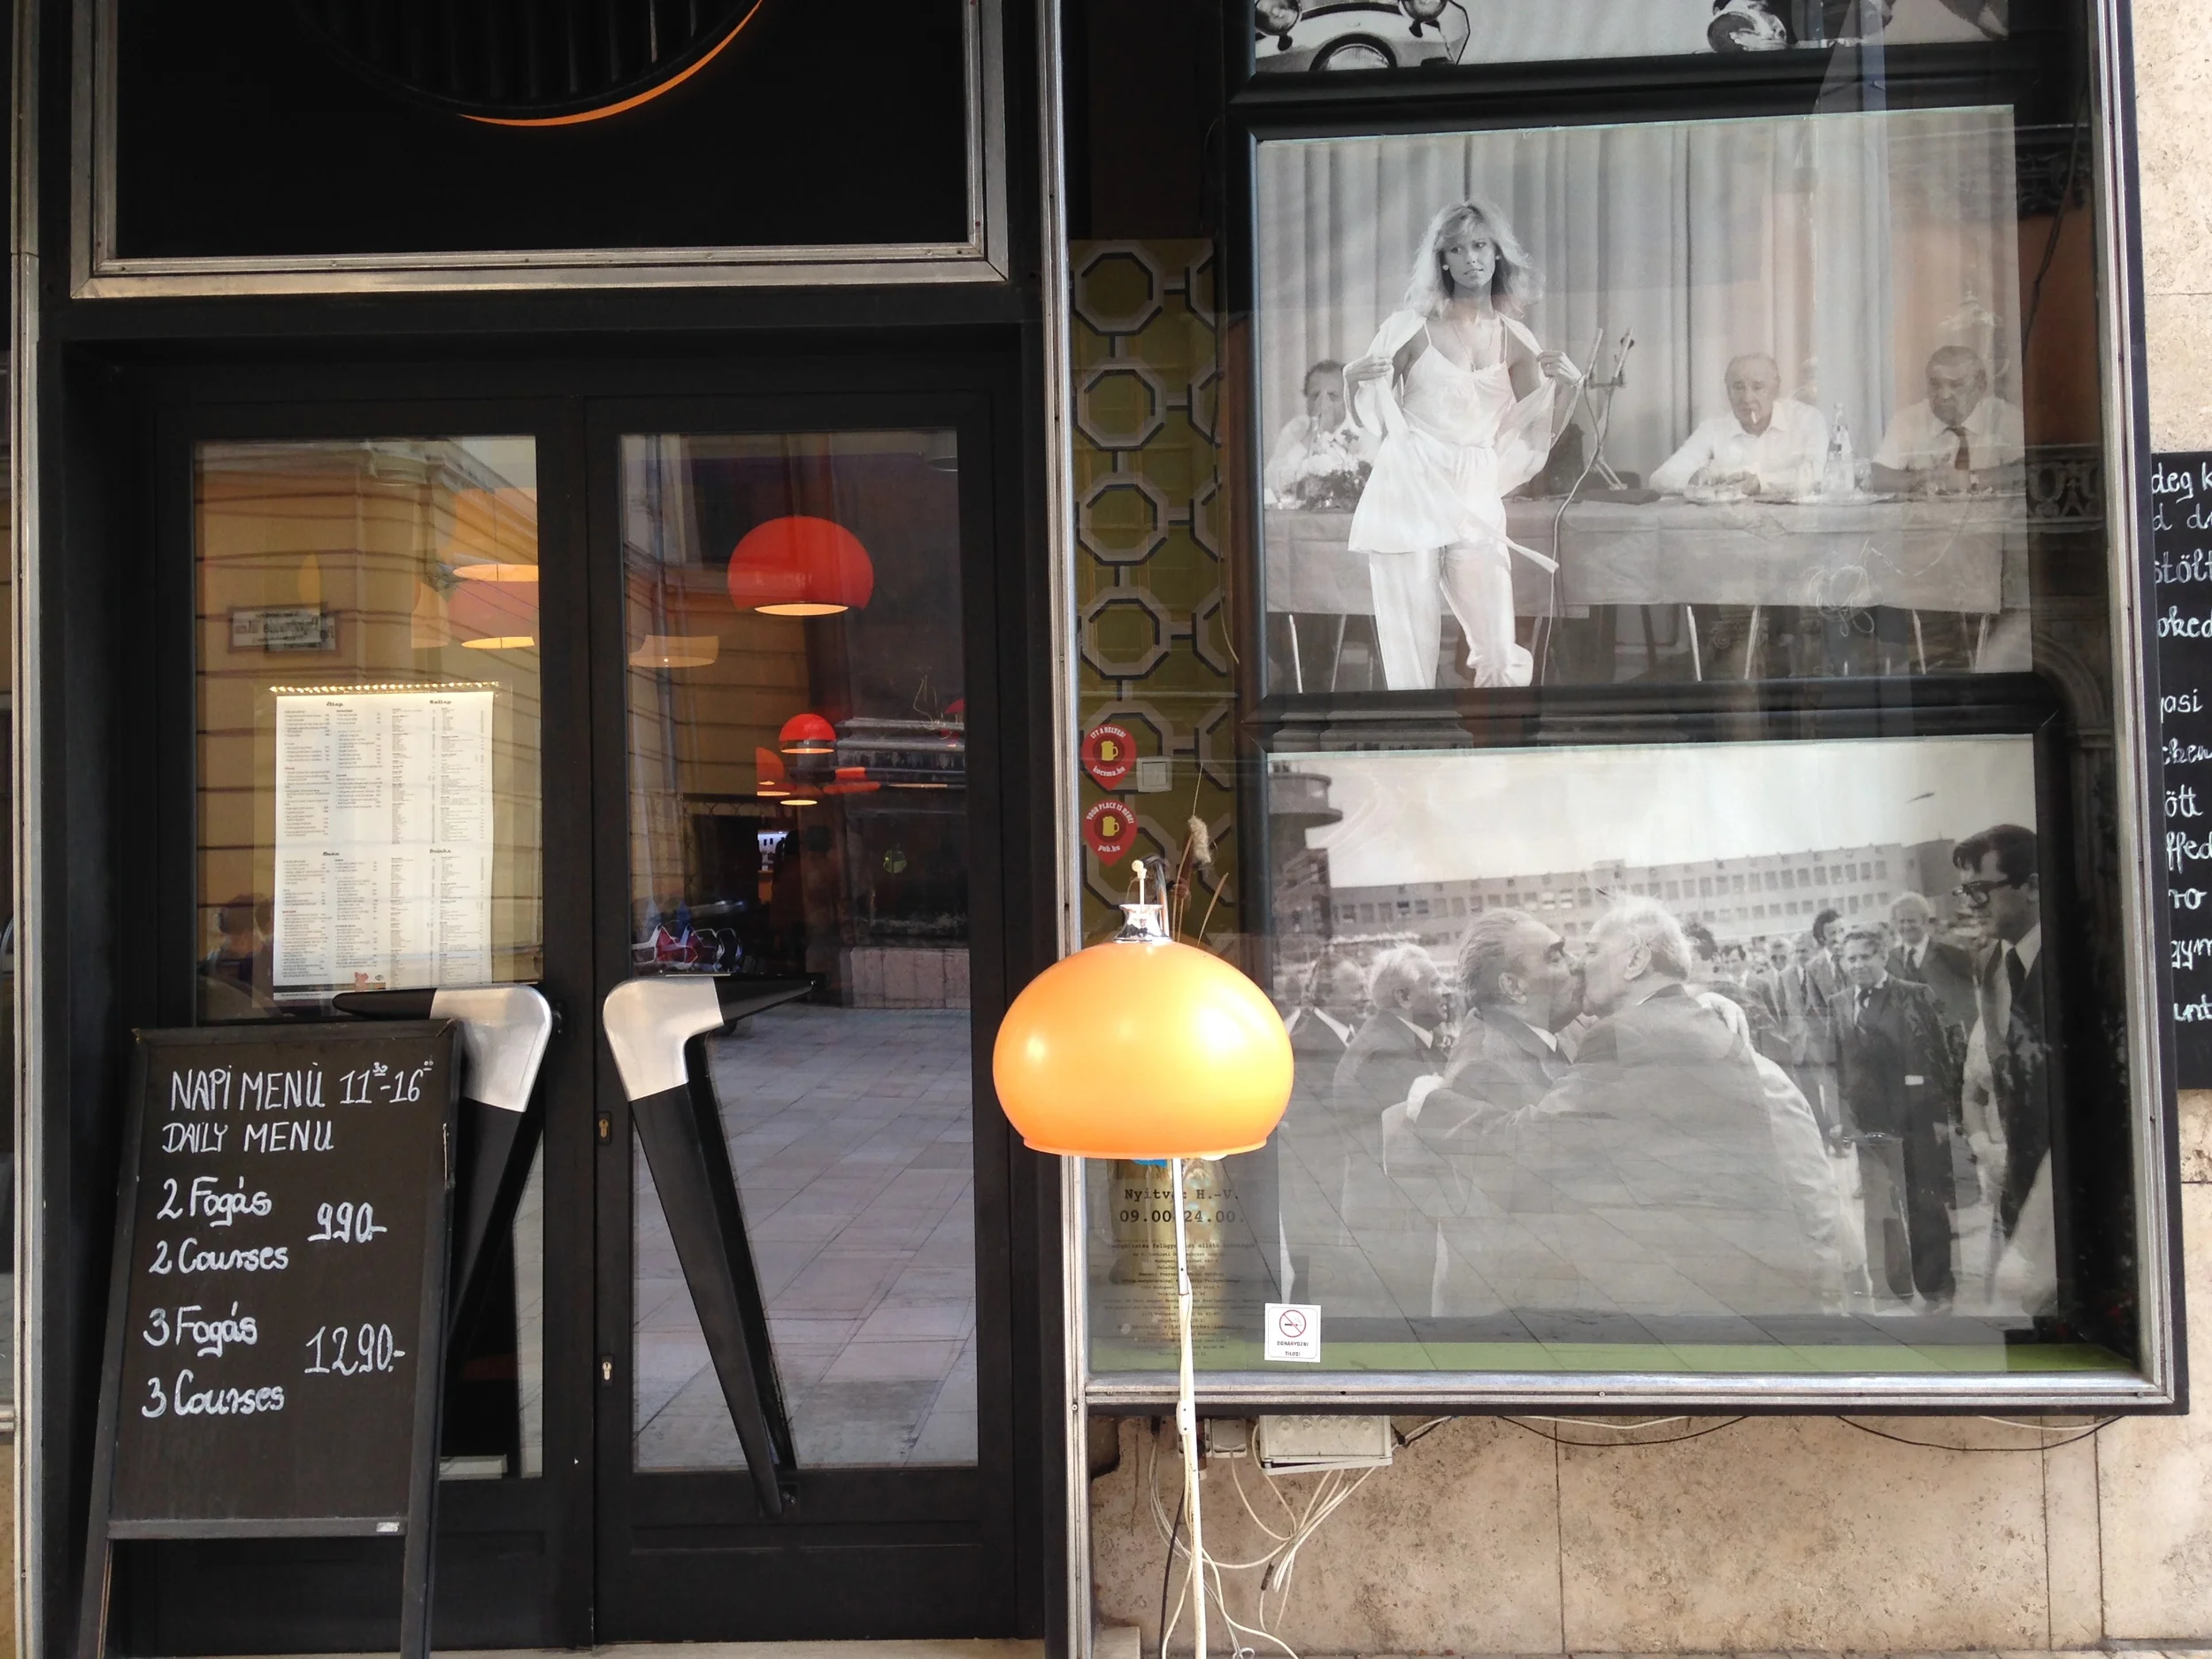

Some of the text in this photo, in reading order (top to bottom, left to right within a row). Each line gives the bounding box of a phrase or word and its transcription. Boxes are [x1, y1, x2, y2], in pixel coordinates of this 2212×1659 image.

[1092, 765, 1125, 777] kocsma.hu
[1086, 806, 1100, 820] YOUR
[1098, 802, 1117, 810] PLACE
[1121, 808, 1135, 824] HERE!
[162, 1120, 334, 1153] DAILY MENU
[157, 1176, 272, 1227] 2 Fogás
[1125, 1188, 1187, 1202] Nyitv:
[1119, 1210, 1245, 1224] 09.0024.00.
[149, 1238, 288, 1274] 2 Courses
[143, 1302, 257, 1357] 3 Fogás
[142, 1370, 284, 1417] 3 Courses
